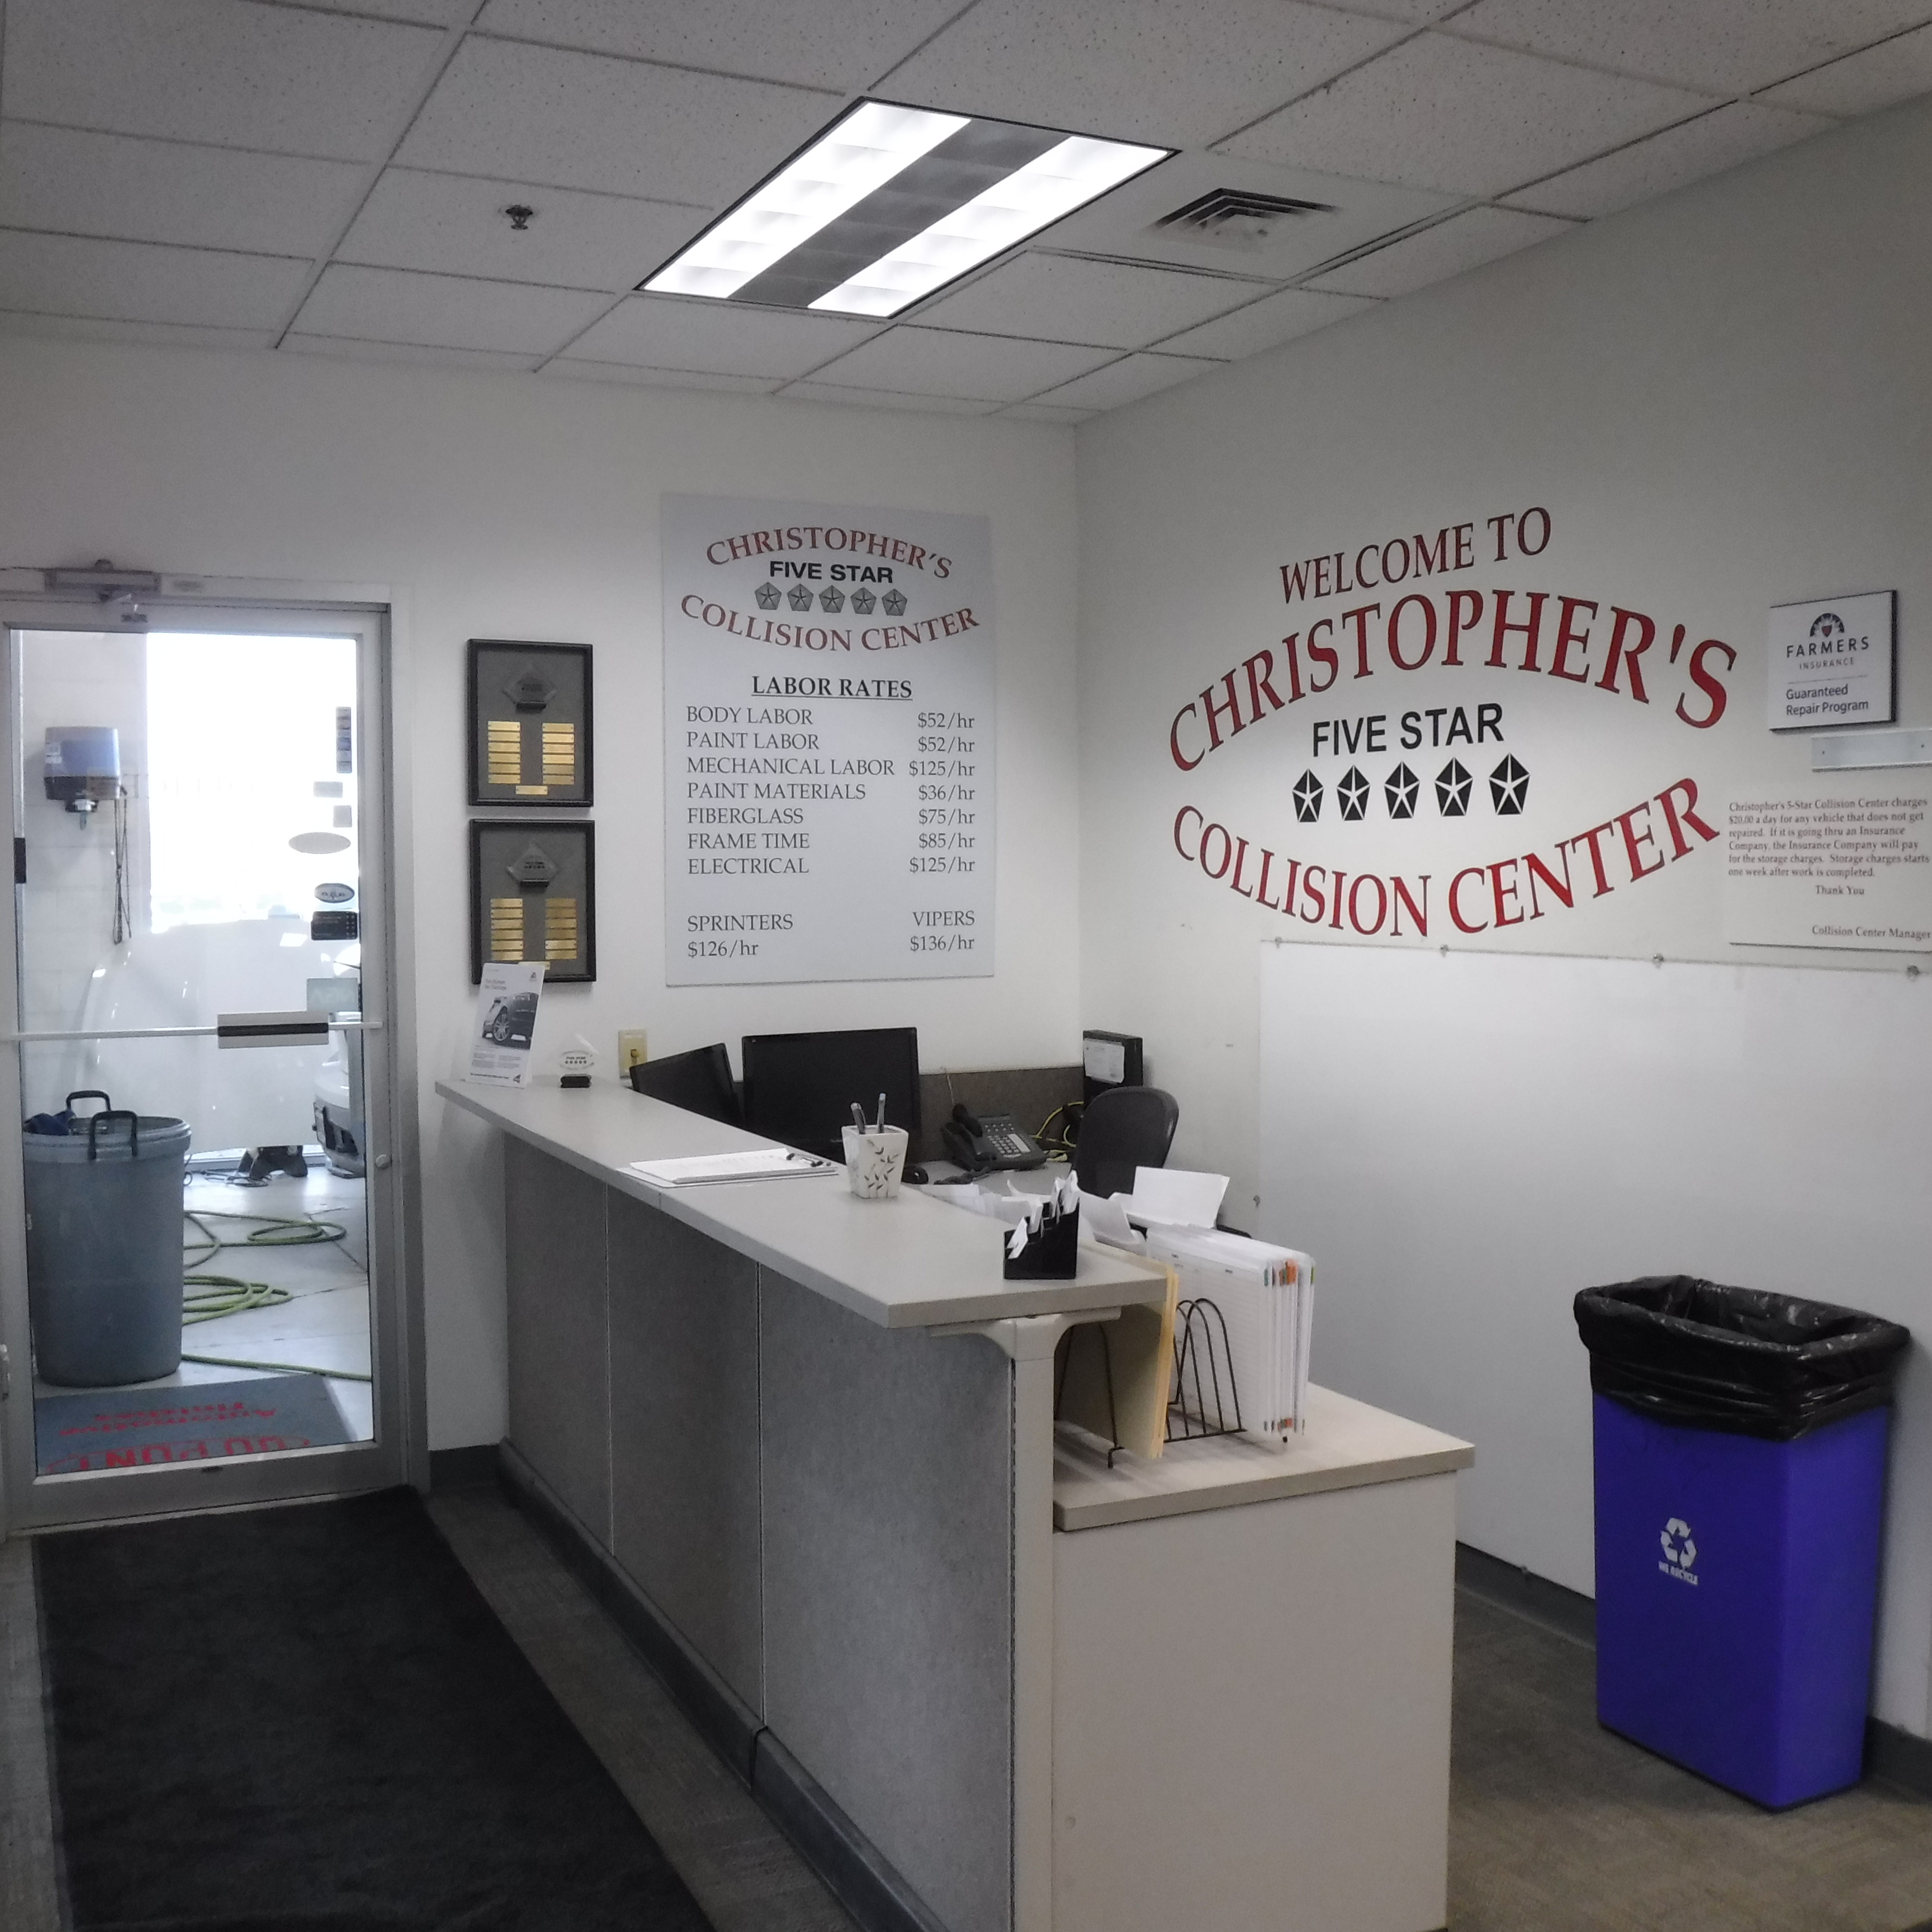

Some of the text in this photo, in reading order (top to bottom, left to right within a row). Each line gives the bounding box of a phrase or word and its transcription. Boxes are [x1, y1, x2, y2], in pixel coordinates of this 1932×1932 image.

[706, 527, 952, 579] CHRISTOPHER'S
[1280, 506, 1551, 604] WELCOME TO
[769, 560, 893, 584] FIVE STAR
[681, 594, 980, 652] COLLISION CENTER
[1786, 636, 1869, 658] FARMERS
[1799, 657, 1854, 669] INSURANCE
[752, 675, 913, 699] LABOR RATES
[1169, 589, 1737, 771] CHRISTOPHER'S
[1786, 683, 1848, 700] Guaranteed
[686, 706, 813, 725] BODY LABOR
[1786, 700, 1869, 717] Repair Program
[917, 712, 975, 729] $52/hr
[1313, 703, 1505, 757] FIVE STAR
[686, 731, 820, 750] PAINT LABOR
[917, 736, 975, 754] $52/hr
[687, 757, 895, 776] MECHANICAL LABOR
[908, 760, 975, 778] $125/hr
[687, 783, 866, 800] PAINT MATERIALS
[918, 784, 975, 802] $36/hr
[1729, 797, 1928, 813] Christopher's 5-Star Collision Center charges
[688, 808, 804, 824] FIBERGLASS
[918, 808, 975, 826] $75/hr
[1763, 815, 1777, 825] day
[1781, 815, 1792, 823] for
[1794, 817, 1809, 826] any
[1813, 813, 1844, 822] vehicle
[1847, 813, 1864, 821] that
[1867, 812, 1888, 821] does
[1909, 812, 1924, 823] get
[688, 833, 810, 849] FRAME TIME
[918, 832, 975, 850] $85/hr
[1770, 827, 1778, 836] If
[1797, 829, 1822, 839] going
[1825, 826, 1843, 835] thru
[1860, 826, 1905, 835] Insurance
[1729, 841, 1770, 853] Company,
[1789, 840, 1831, 849] Insurance
[1834, 840, 1877, 851] Company
[1881, 840, 1899, 848] will
[1902, 841, 1918, 851] pay
[910, 857, 975, 874] $125/hr
[1173, 778, 1721, 937] COLLISION CENTER
[1729, 855, 1740, 863] for
[1742, 854, 1755, 863] the
[1758, 856, 1788, 865] storage
[1830, 854, 1863, 865] Storage
[1866, 854, 1901, 866] charges
[1903, 854, 1930, 863] starts
[688, 858, 809, 875] ELECTRICAL
[1746, 866, 1767, 875] week
[1769, 867, 1789, 875] after
[1792, 867, 1813, 876] work
[1826, 866, 1875, 879] completed.
[1816, 885, 1864, 894] Thank You
[687, 913, 793, 931] SPRINTERS
[912, 911, 975, 926] VIPERS
[1812, 925, 1931, 941] Collision Center Manager
[688, 940, 758, 959] $126/hr
[910, 935, 974, 952] $136/hr
